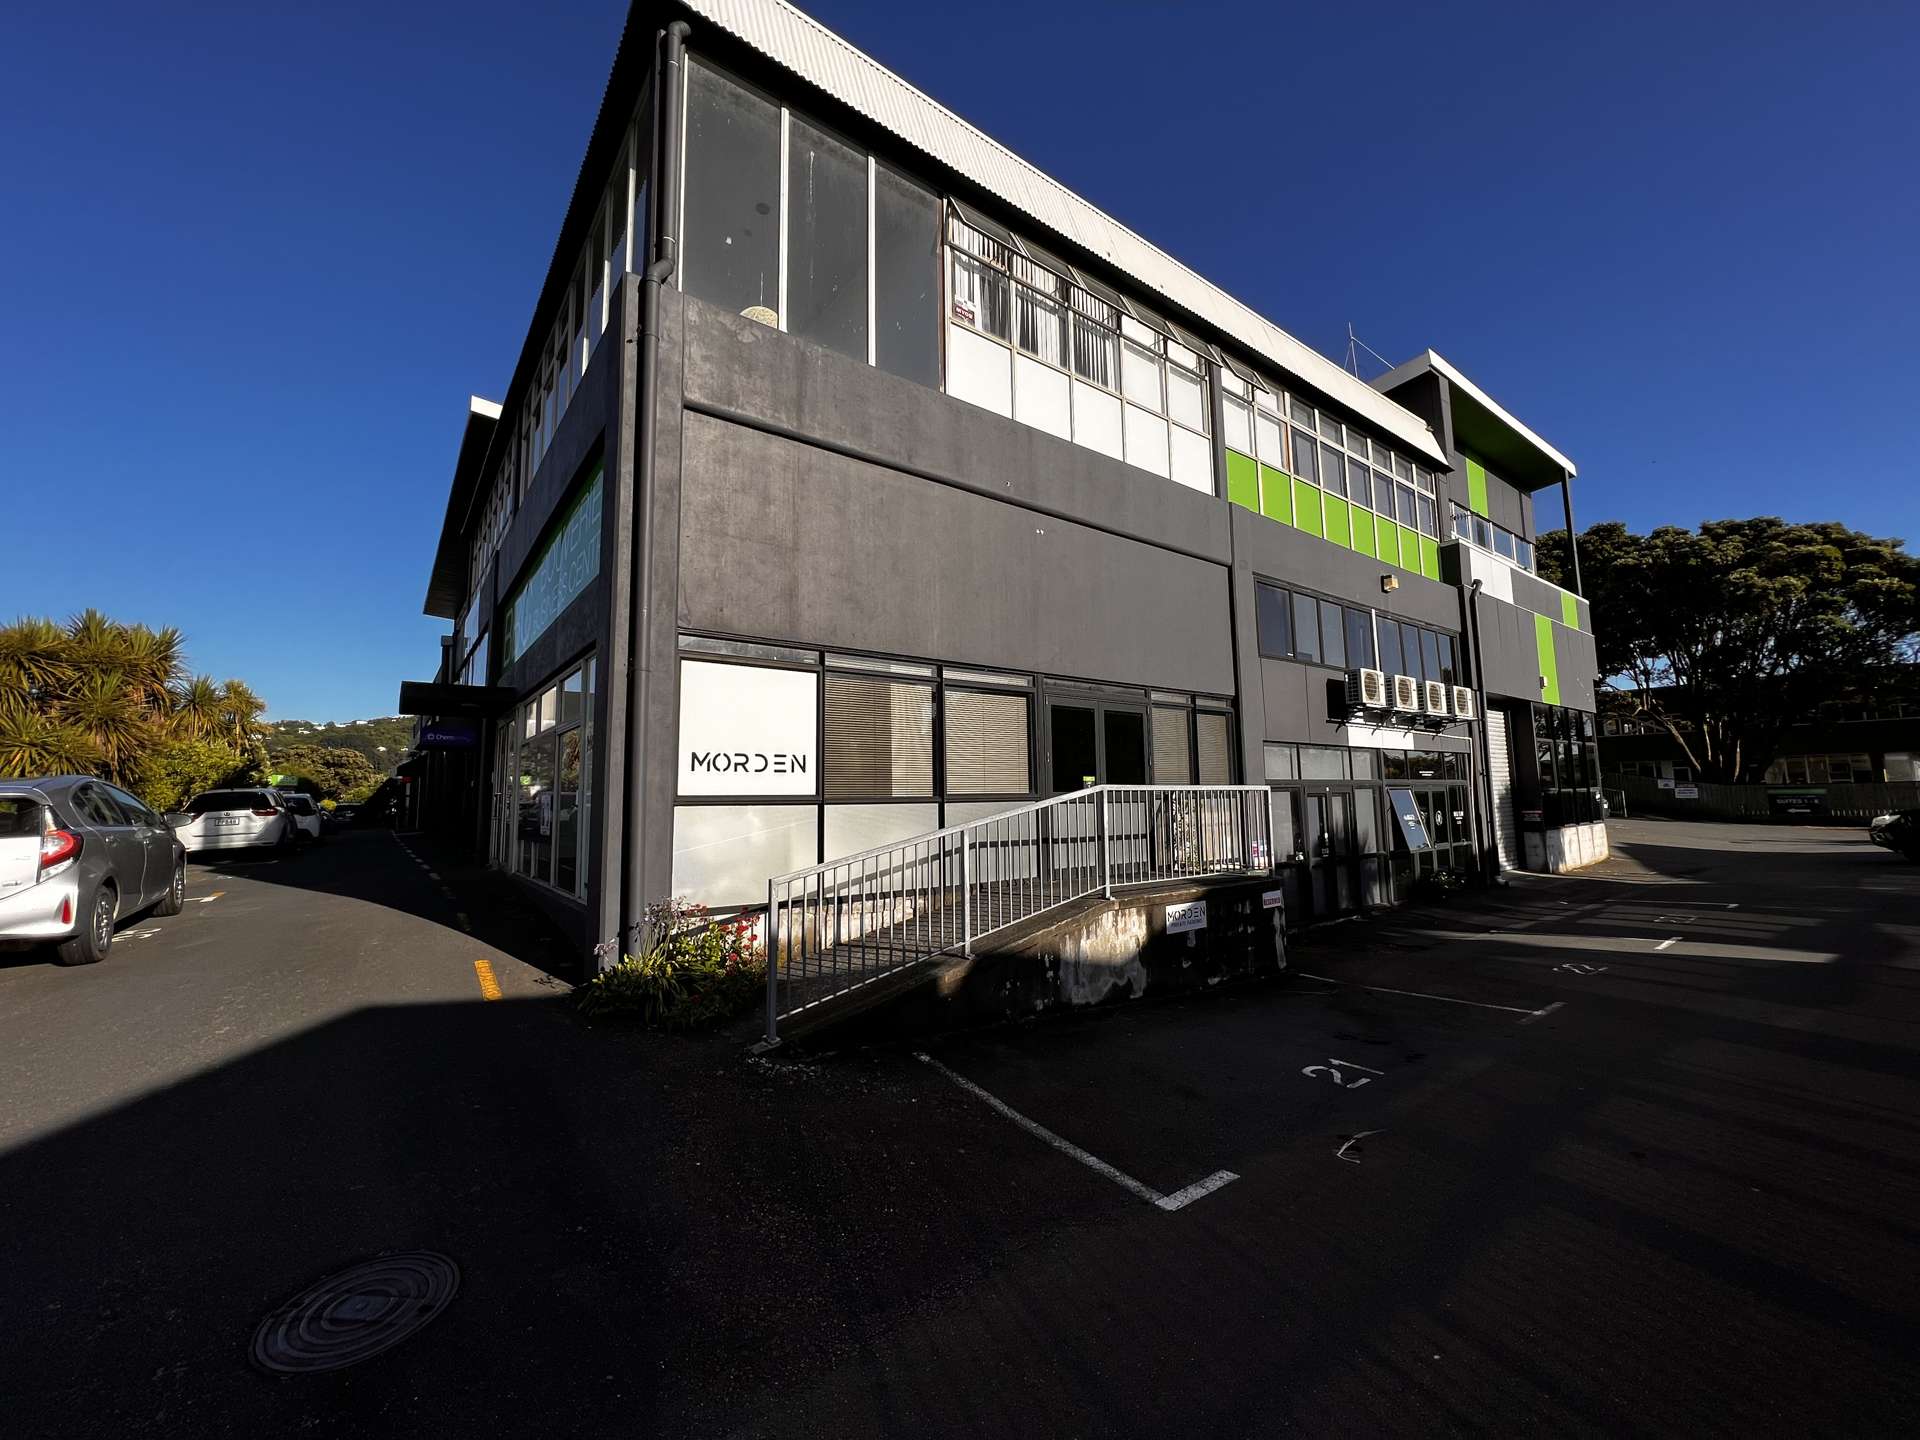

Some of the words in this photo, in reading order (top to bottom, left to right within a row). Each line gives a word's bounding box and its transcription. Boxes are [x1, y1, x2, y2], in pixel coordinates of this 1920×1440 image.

[691, 752, 806, 774] MORDEN
[1167, 906, 1206, 922] MORDEN
[1301, 1058, 1384, 1089] 21
